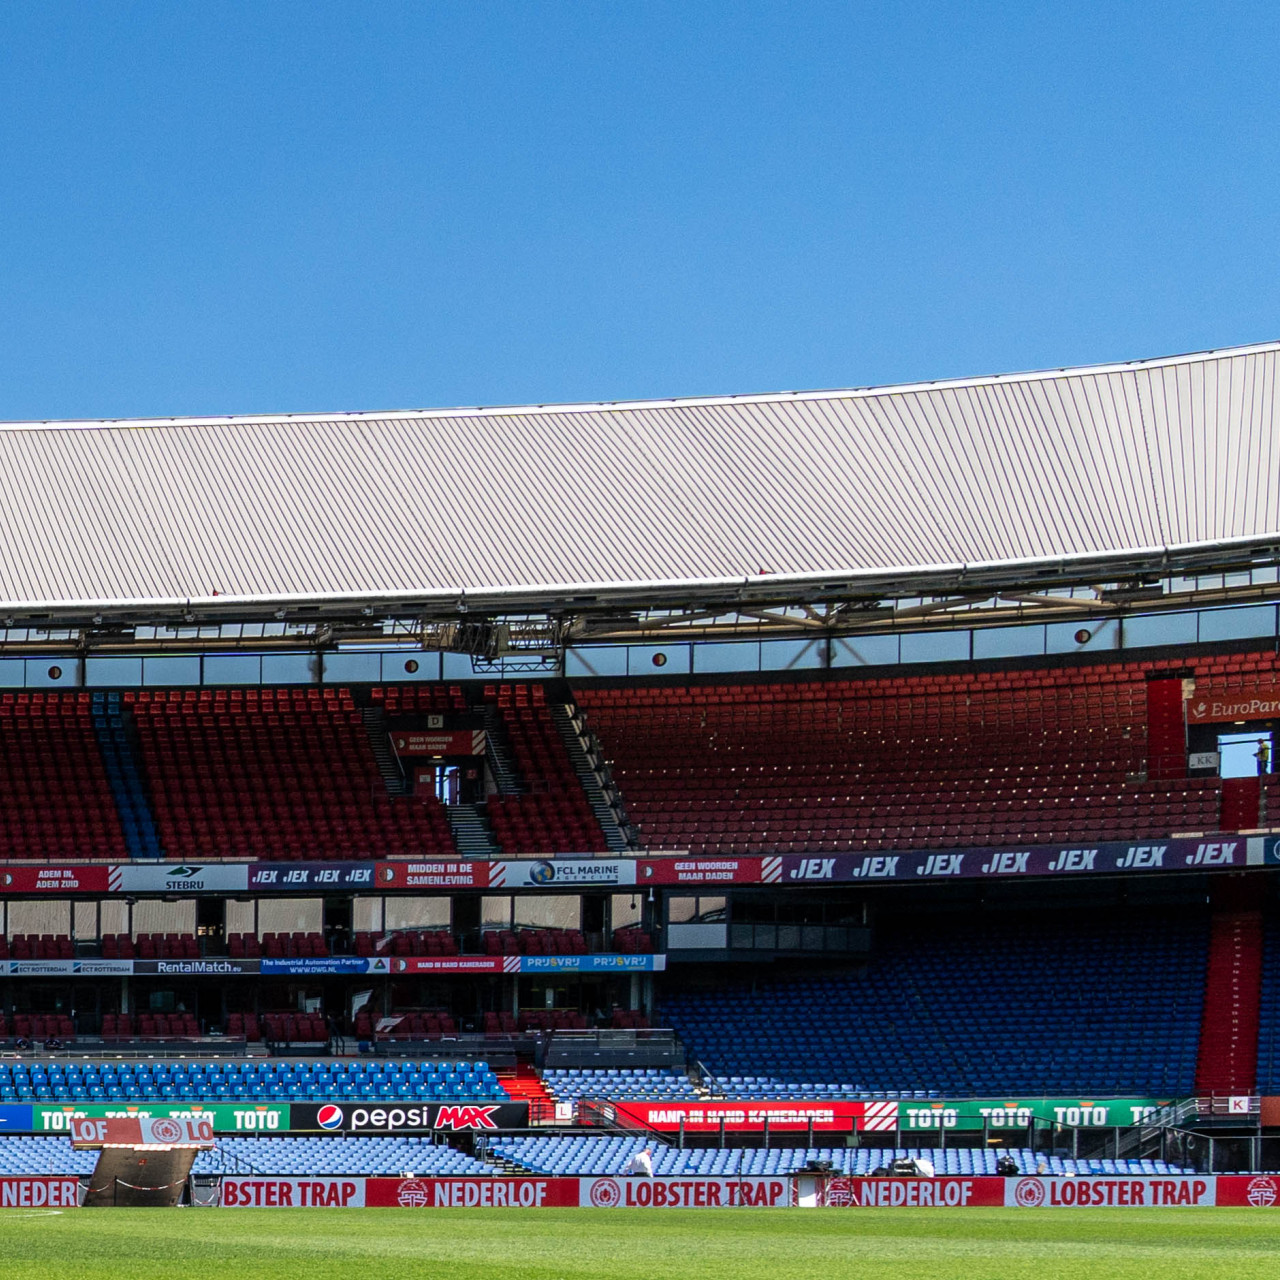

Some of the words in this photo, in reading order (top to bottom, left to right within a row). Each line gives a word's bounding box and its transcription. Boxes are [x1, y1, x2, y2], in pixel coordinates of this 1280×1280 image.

[1197, 755, 1213, 765] KK
[407, 864, 440, 874] MIDDEN
[443, 864, 456, 874] IN
[460, 864, 472, 874] DE
[556, 866, 574, 875] FCL
[577, 865, 619, 875] MARINE
[674, 862, 696, 870] GEEN
[697, 862, 738, 870] WOORDEN
[790, 858, 836, 879] JEX
[852, 856, 898, 877] JEX
[916, 854, 964, 876] JEX
[982, 852, 1030, 874] JEX
[1048, 850, 1098, 870] JEX
[1116, 846, 1164, 868] JEX
[1186, 843, 1234, 865] JEX
[36, 880, 58, 888] ADEM
[60, 880, 78, 888] ZUID
[38, 870, 60, 879] ADEM
[63, 870, 74, 880] IN,
[406, 875, 473, 886] SAMENLEVING
[678, 872, 700, 880] MAAR
[702, 872, 734, 880] DADEN
[166, 880, 204, 890] STEBRU
[158, 962, 242, 973] RentalMatch.eu
[1233, 1100, 1242, 1110] K
[233, 1110, 280, 1129] TOTO
[351, 1106, 428, 1130] pepsi
[434, 1106, 501, 1130] MAX
[648, 1110, 686, 1124] HAND
[688, 1110, 704, 1124] IN
[706, 1110, 746, 1124] HAND
[748, 1110, 834, 1124] KAMERADEN
[906, 1109, 957, 1128] TOTO
[979, 1108, 1032, 1126] TOTO
[1054, 1107, 1108, 1126] TOTO
[72, 1121, 108, 1141] LOF
[186, 1120, 214, 1141] LO
[2, 1182, 77, 1207] NEDER
[223, 1182, 297, 1207] BSTER
[298, 1182, 356, 1206] TRAP
[434, 1182, 547, 1208] NEDERLOF
[625, 1182, 723, 1207] LOBSTER
[725, 1182, 783, 1207] TRAP
[860, 1182, 972, 1206] NEDERLOF
[1050, 1180, 1144, 1206] LOBSTER
[1148, 1180, 1206, 1206] TRAP
